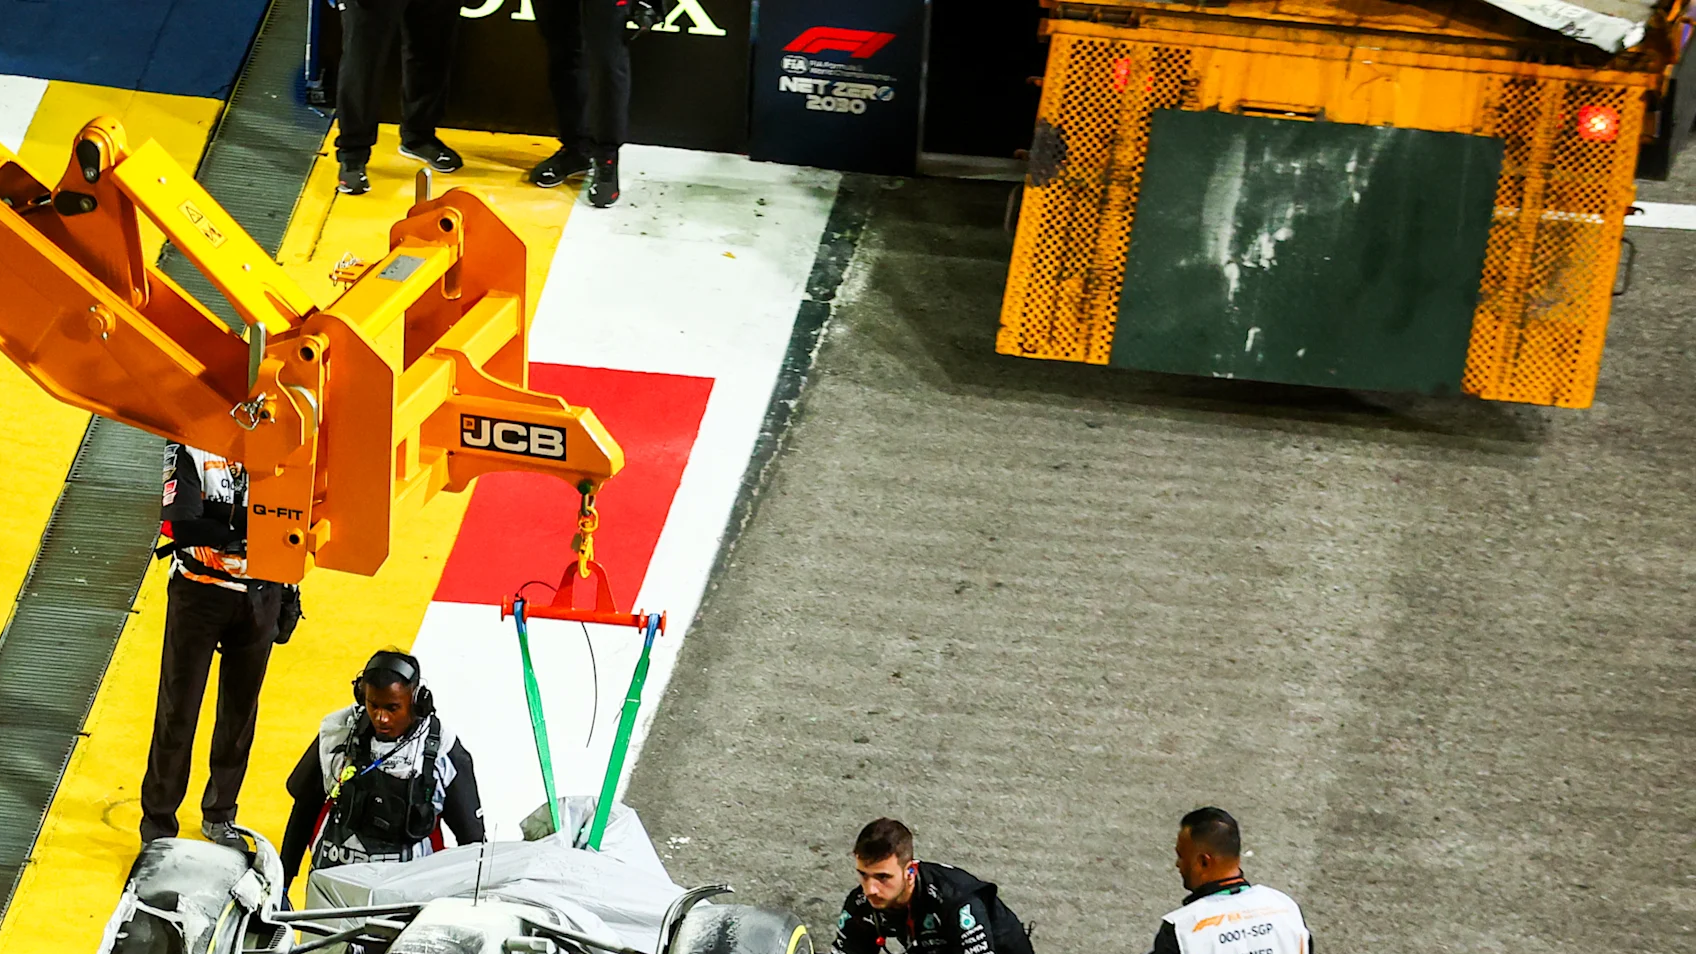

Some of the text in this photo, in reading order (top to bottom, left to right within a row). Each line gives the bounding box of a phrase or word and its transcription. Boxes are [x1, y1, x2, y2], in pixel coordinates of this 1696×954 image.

[778, 75, 894, 101] NET ZERO
[805, 94, 867, 114] 2030
[463, 420, 564, 457] JCB
[253, 504, 303, 520] Q-FIT
[1219, 923, 1273, 944] 0001-SGP
